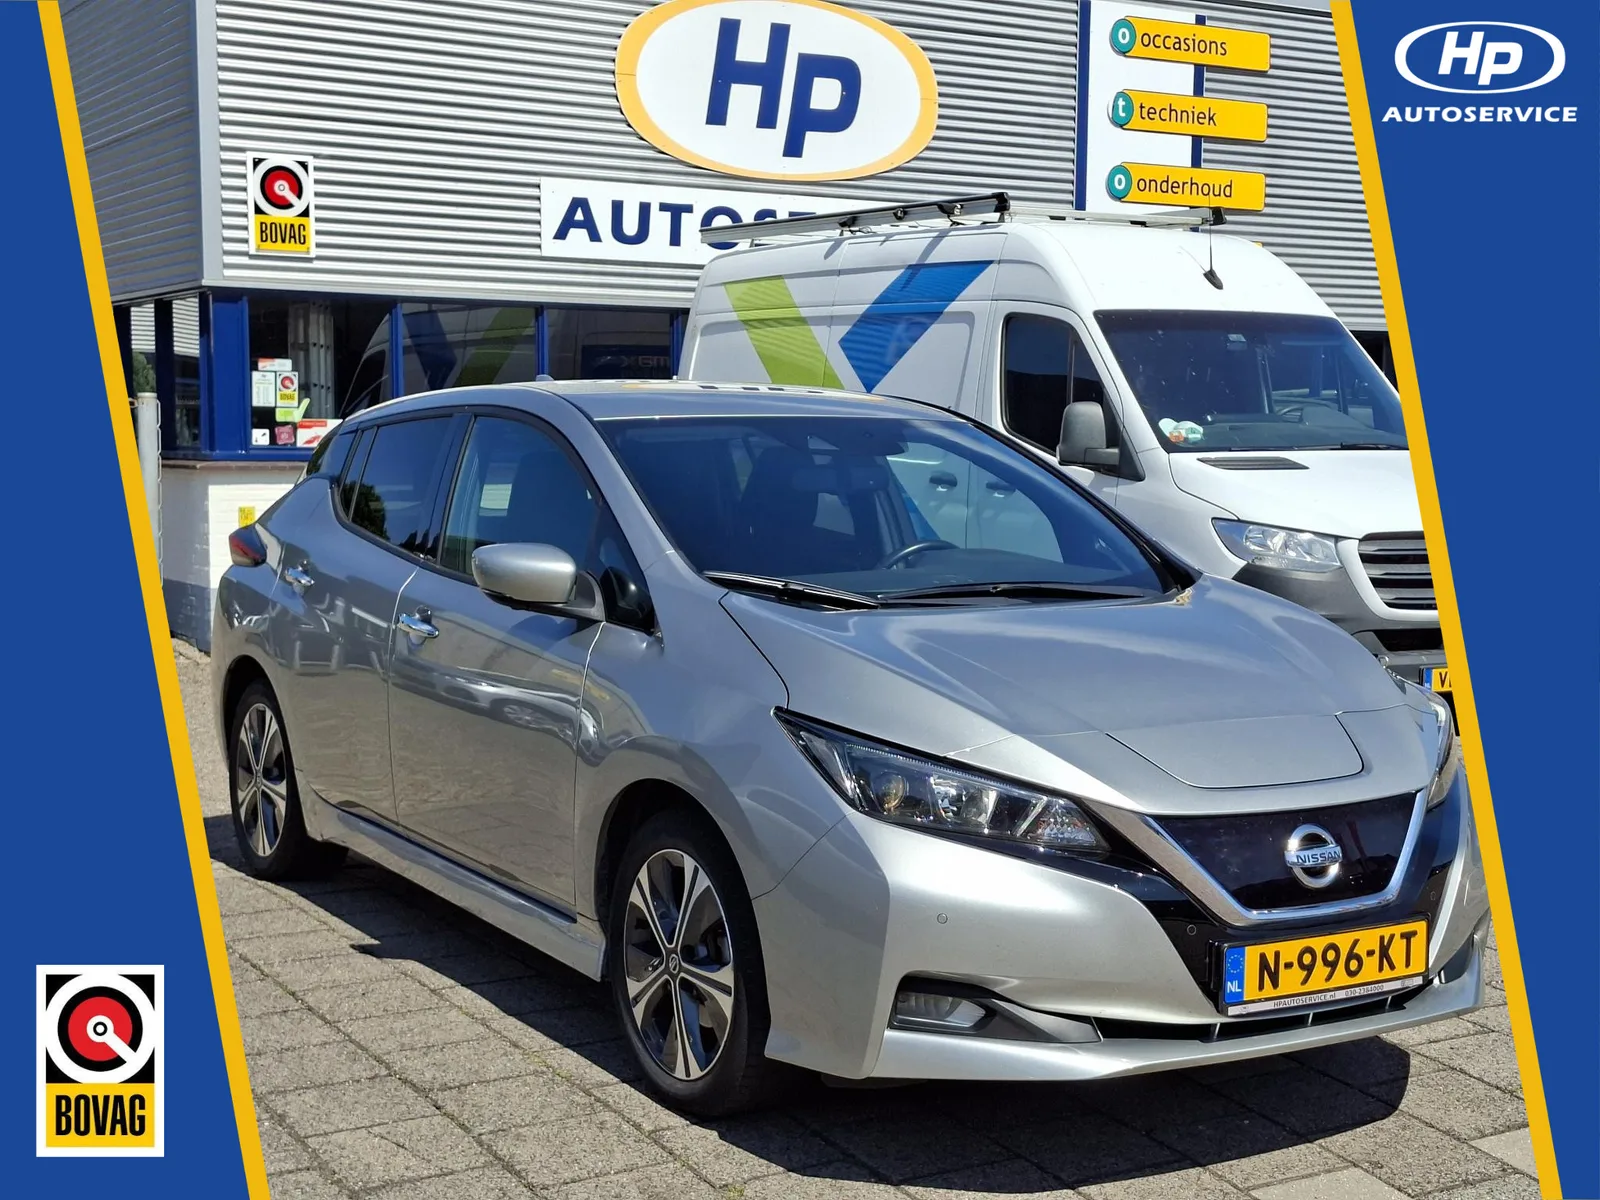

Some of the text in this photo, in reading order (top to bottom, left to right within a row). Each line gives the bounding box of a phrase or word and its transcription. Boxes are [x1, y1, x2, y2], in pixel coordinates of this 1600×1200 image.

[1140, 31, 1228, 56] occasions
[1139, 102, 1217, 127] techniek
[1136, 175, 1233, 198] onderhoud
[260, 221, 306, 245] BOVAG
[552, 196, 817, 250] AUTO
[1438, 670, 1452, 688] V
[1295, 850, 1341, 864] NISSAN
[1258, 930, 1418, 993] N-996-KT
[1226, 980, 1242, 994] NL
[1273, 992, 1336, 1008] HPAUTOSERVICE.nl
